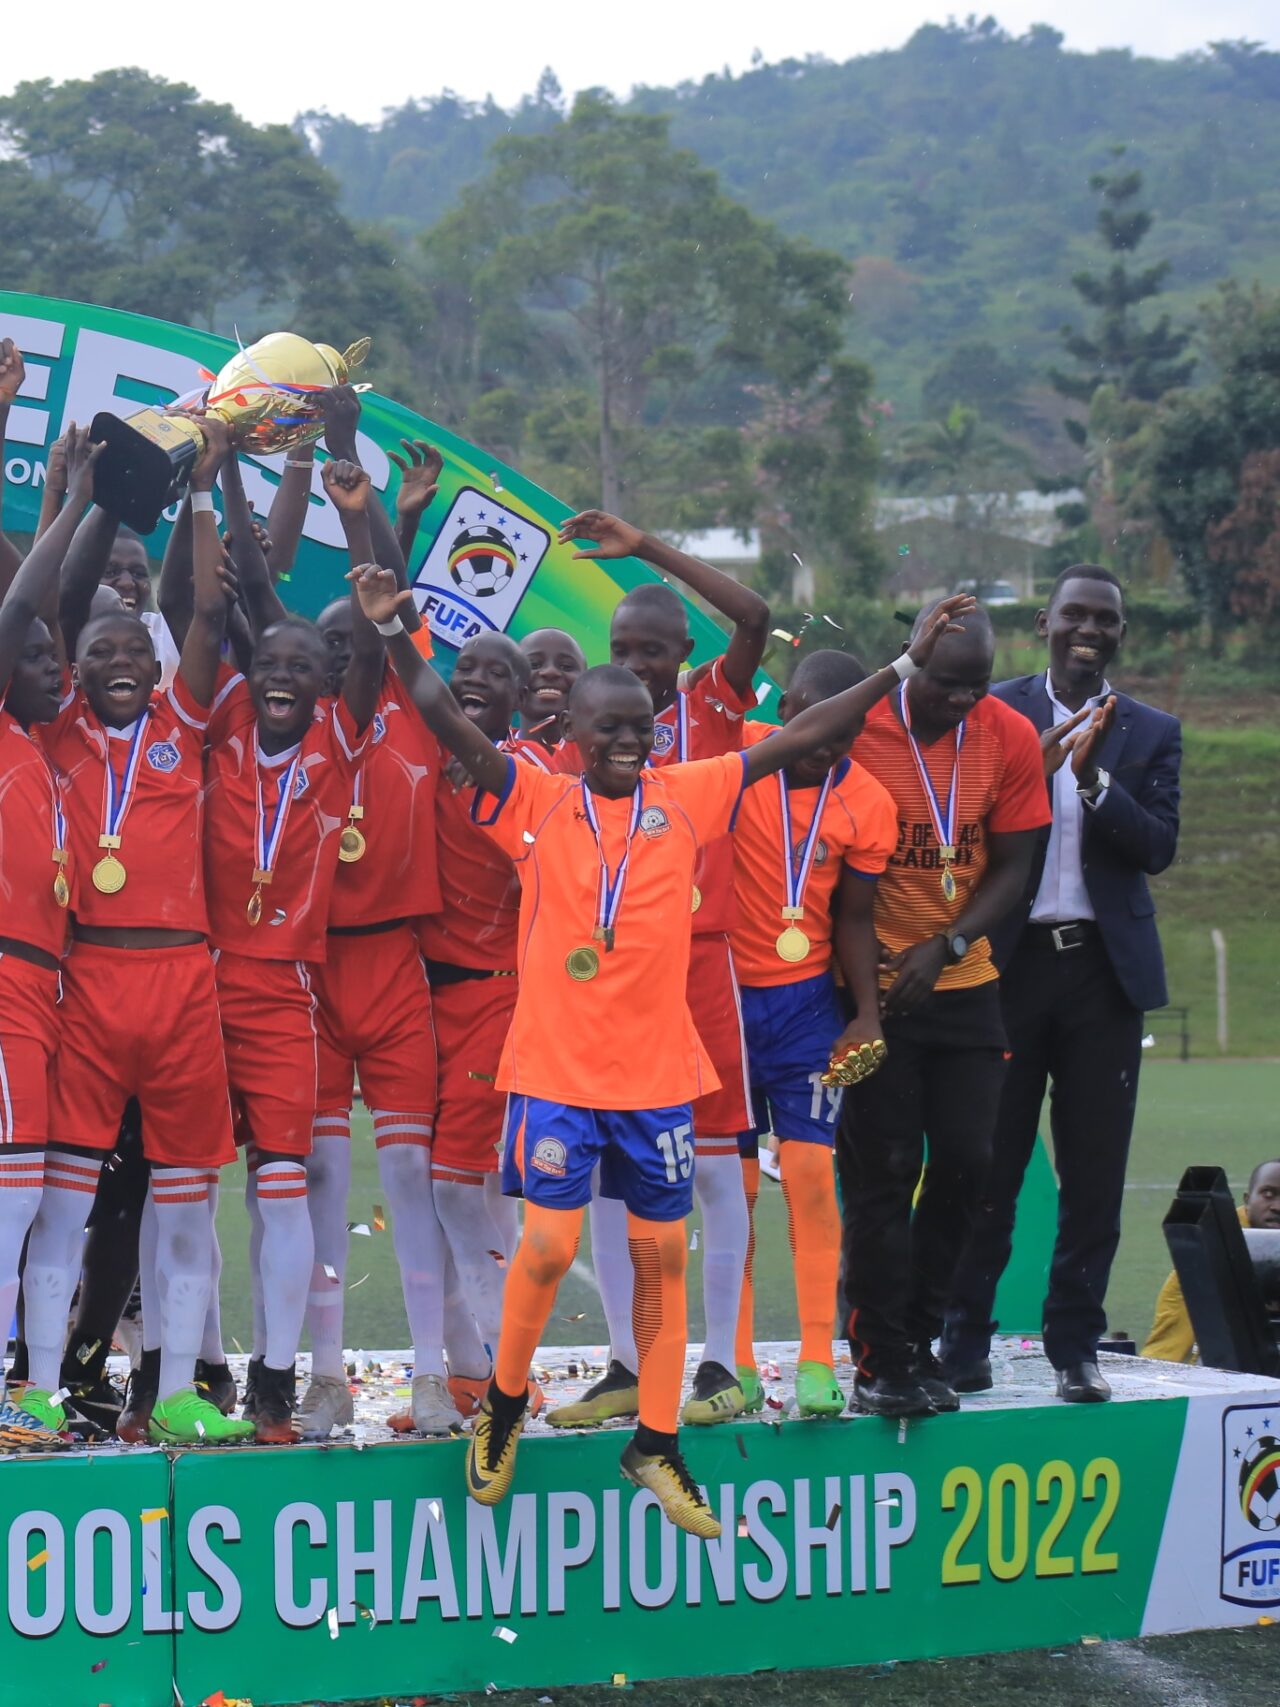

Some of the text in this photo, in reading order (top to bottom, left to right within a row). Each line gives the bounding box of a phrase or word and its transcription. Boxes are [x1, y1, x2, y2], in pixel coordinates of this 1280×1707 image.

[656, 1122, 694, 1183] 15
[274, 1472, 917, 1628] CHAMPIONSHIP
[941, 1456, 1120, 1584] 2022
